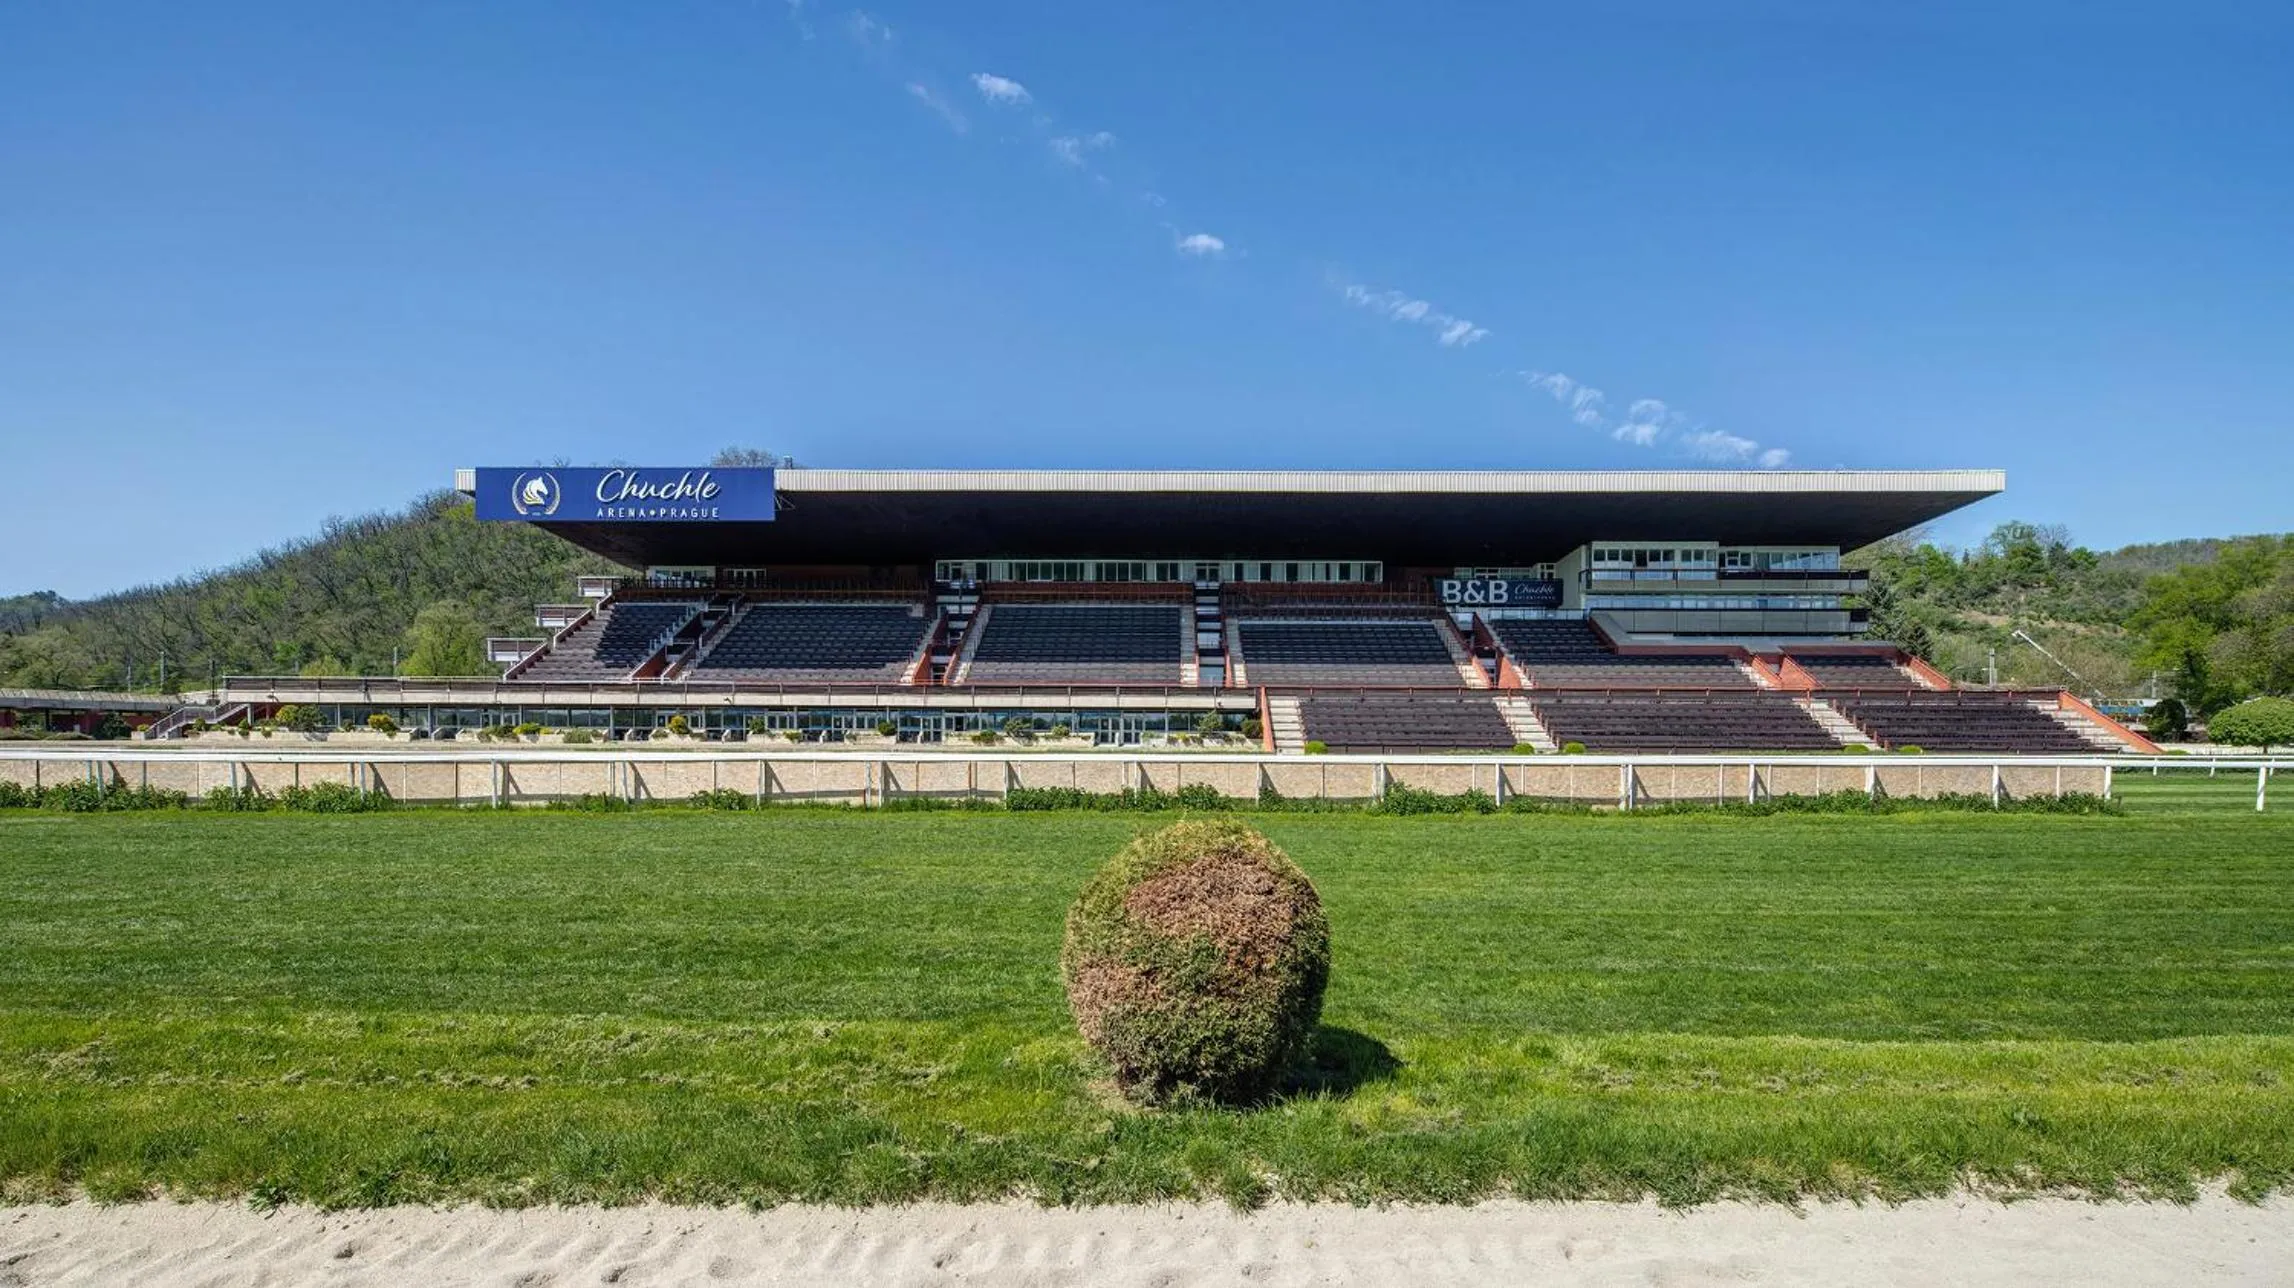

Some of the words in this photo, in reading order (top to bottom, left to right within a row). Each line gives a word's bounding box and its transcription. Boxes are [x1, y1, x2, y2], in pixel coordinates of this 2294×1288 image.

[596, 469, 721, 502] Chuchle
[597, 507, 646, 518] ARENA
[660, 507, 719, 518] PRAGUE
[1442, 580, 1509, 603] B&B
